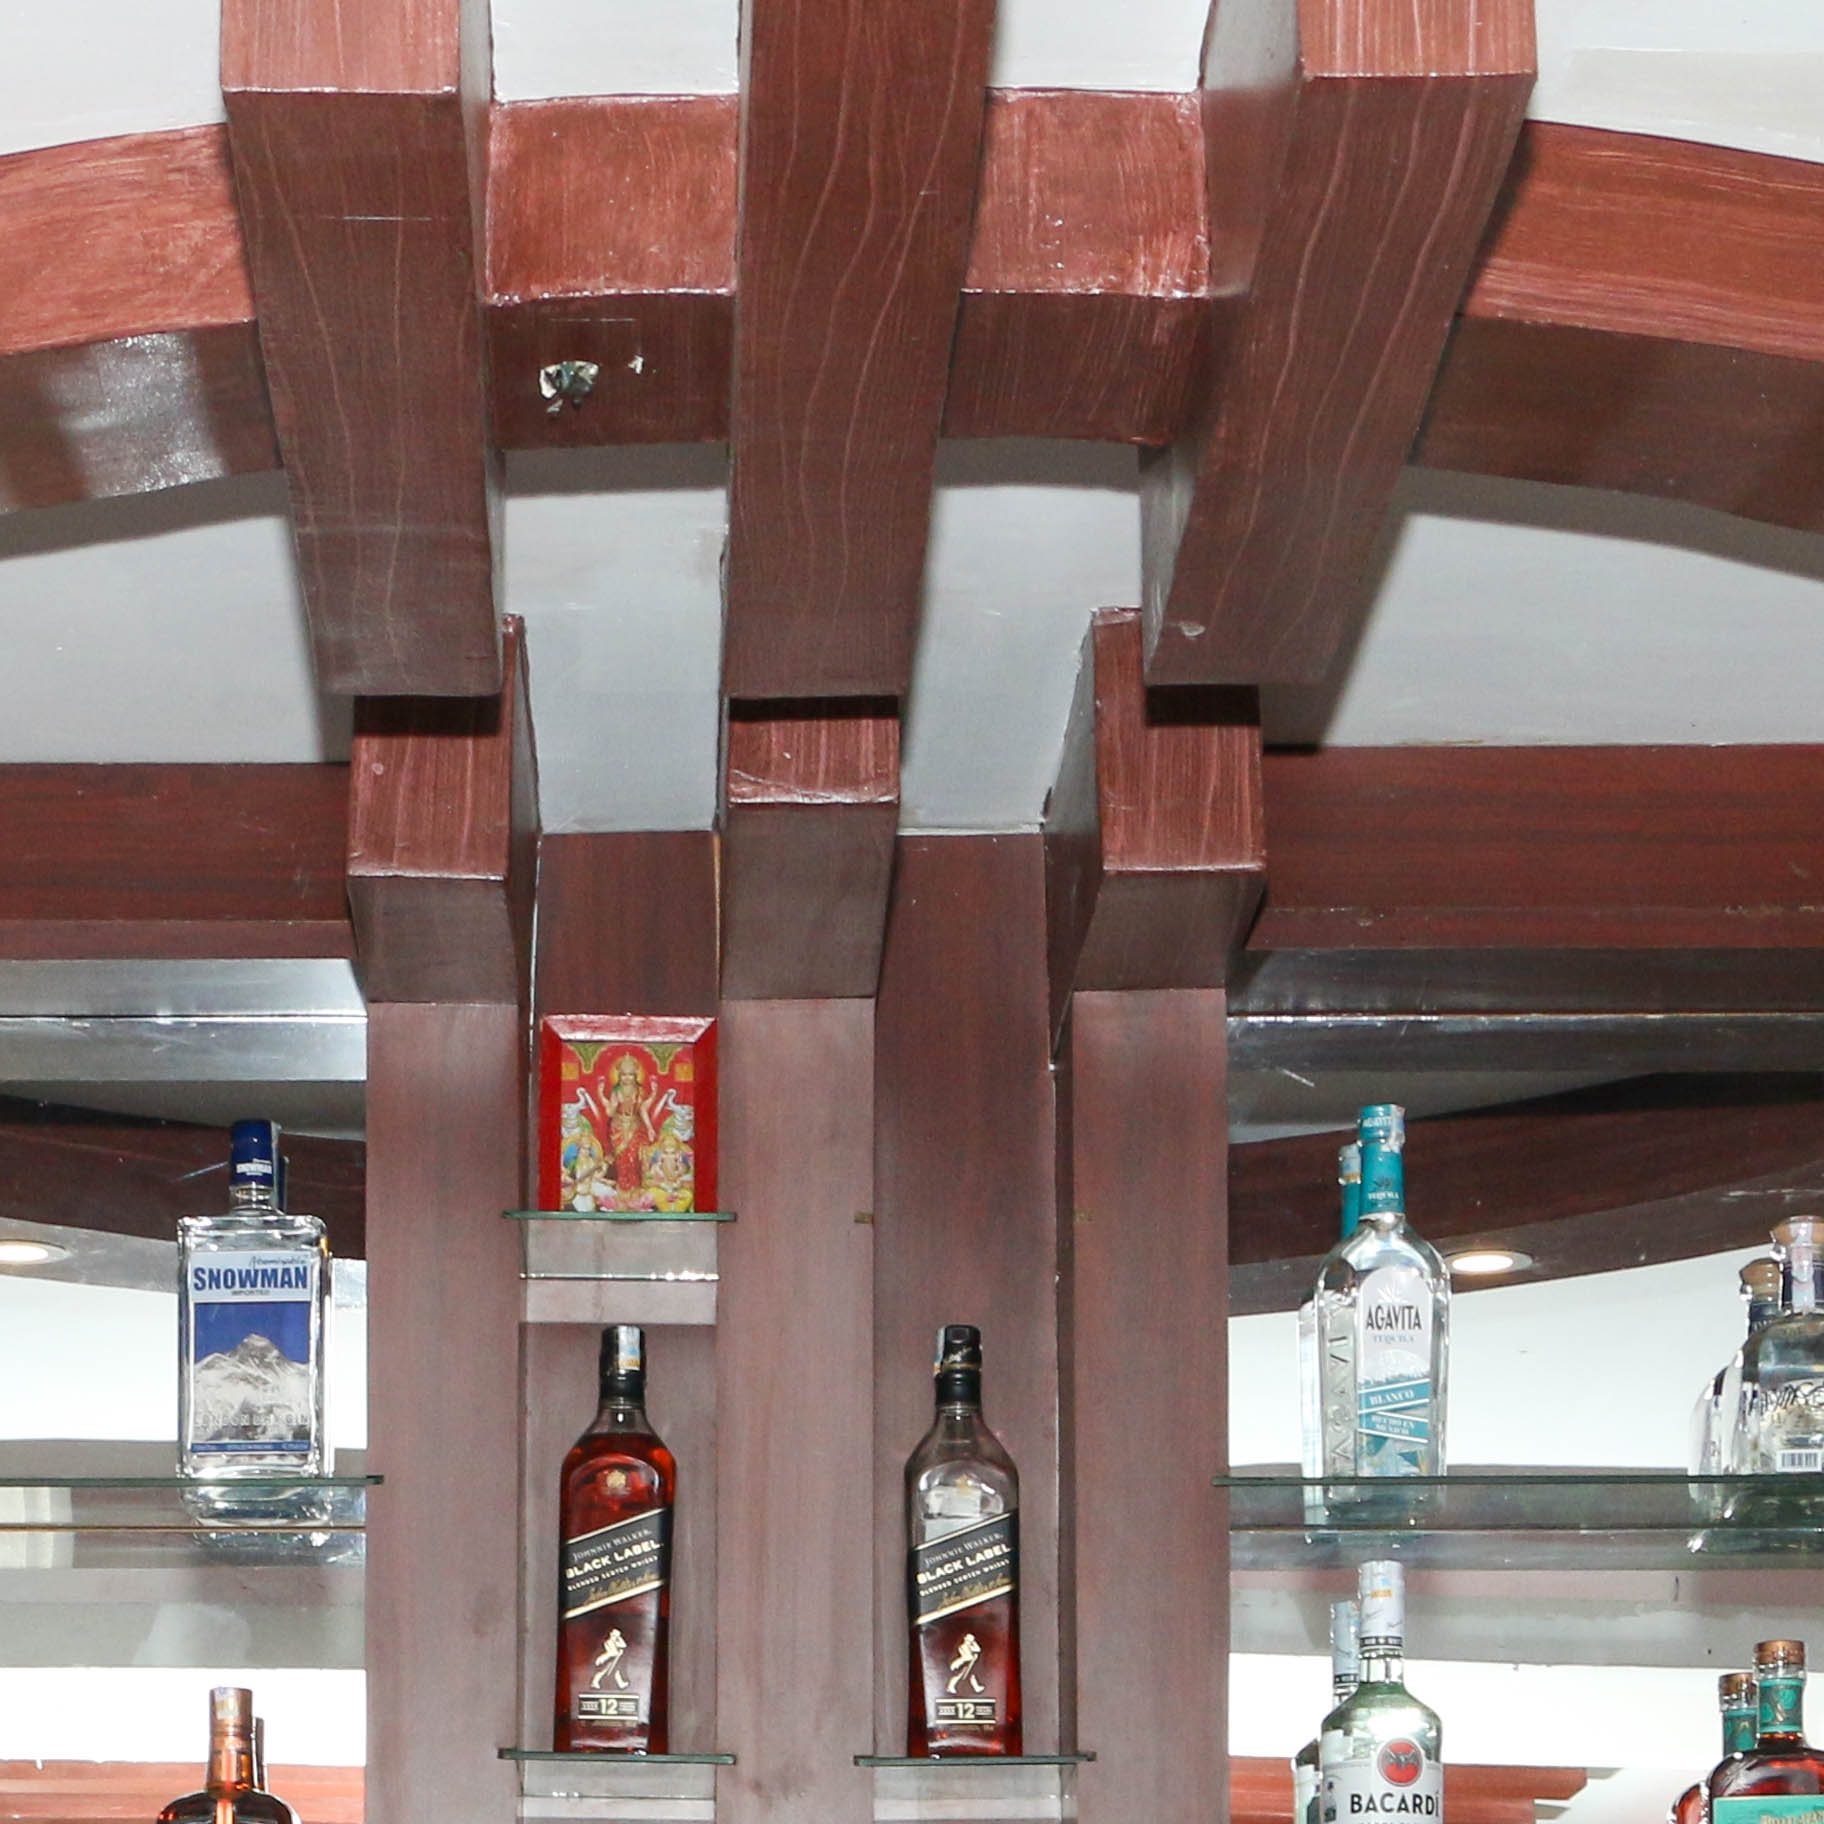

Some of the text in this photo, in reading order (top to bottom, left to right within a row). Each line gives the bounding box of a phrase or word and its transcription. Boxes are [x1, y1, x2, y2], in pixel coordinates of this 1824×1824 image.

[193, 1266, 308, 1291] SNOWMAN
[1366, 1304, 1423, 1331] AGAVITA
[1369, 1389, 1415, 1406] BLANCO
[565, 1539, 661, 1580] BLACK LABEL
[916, 1543, 1012, 1585] BLACK LABEL
[599, 1698, 619, 1715] 12
[956, 1702, 976, 1719] 12
[1349, 1791, 1441, 1819] BACARDÍ
